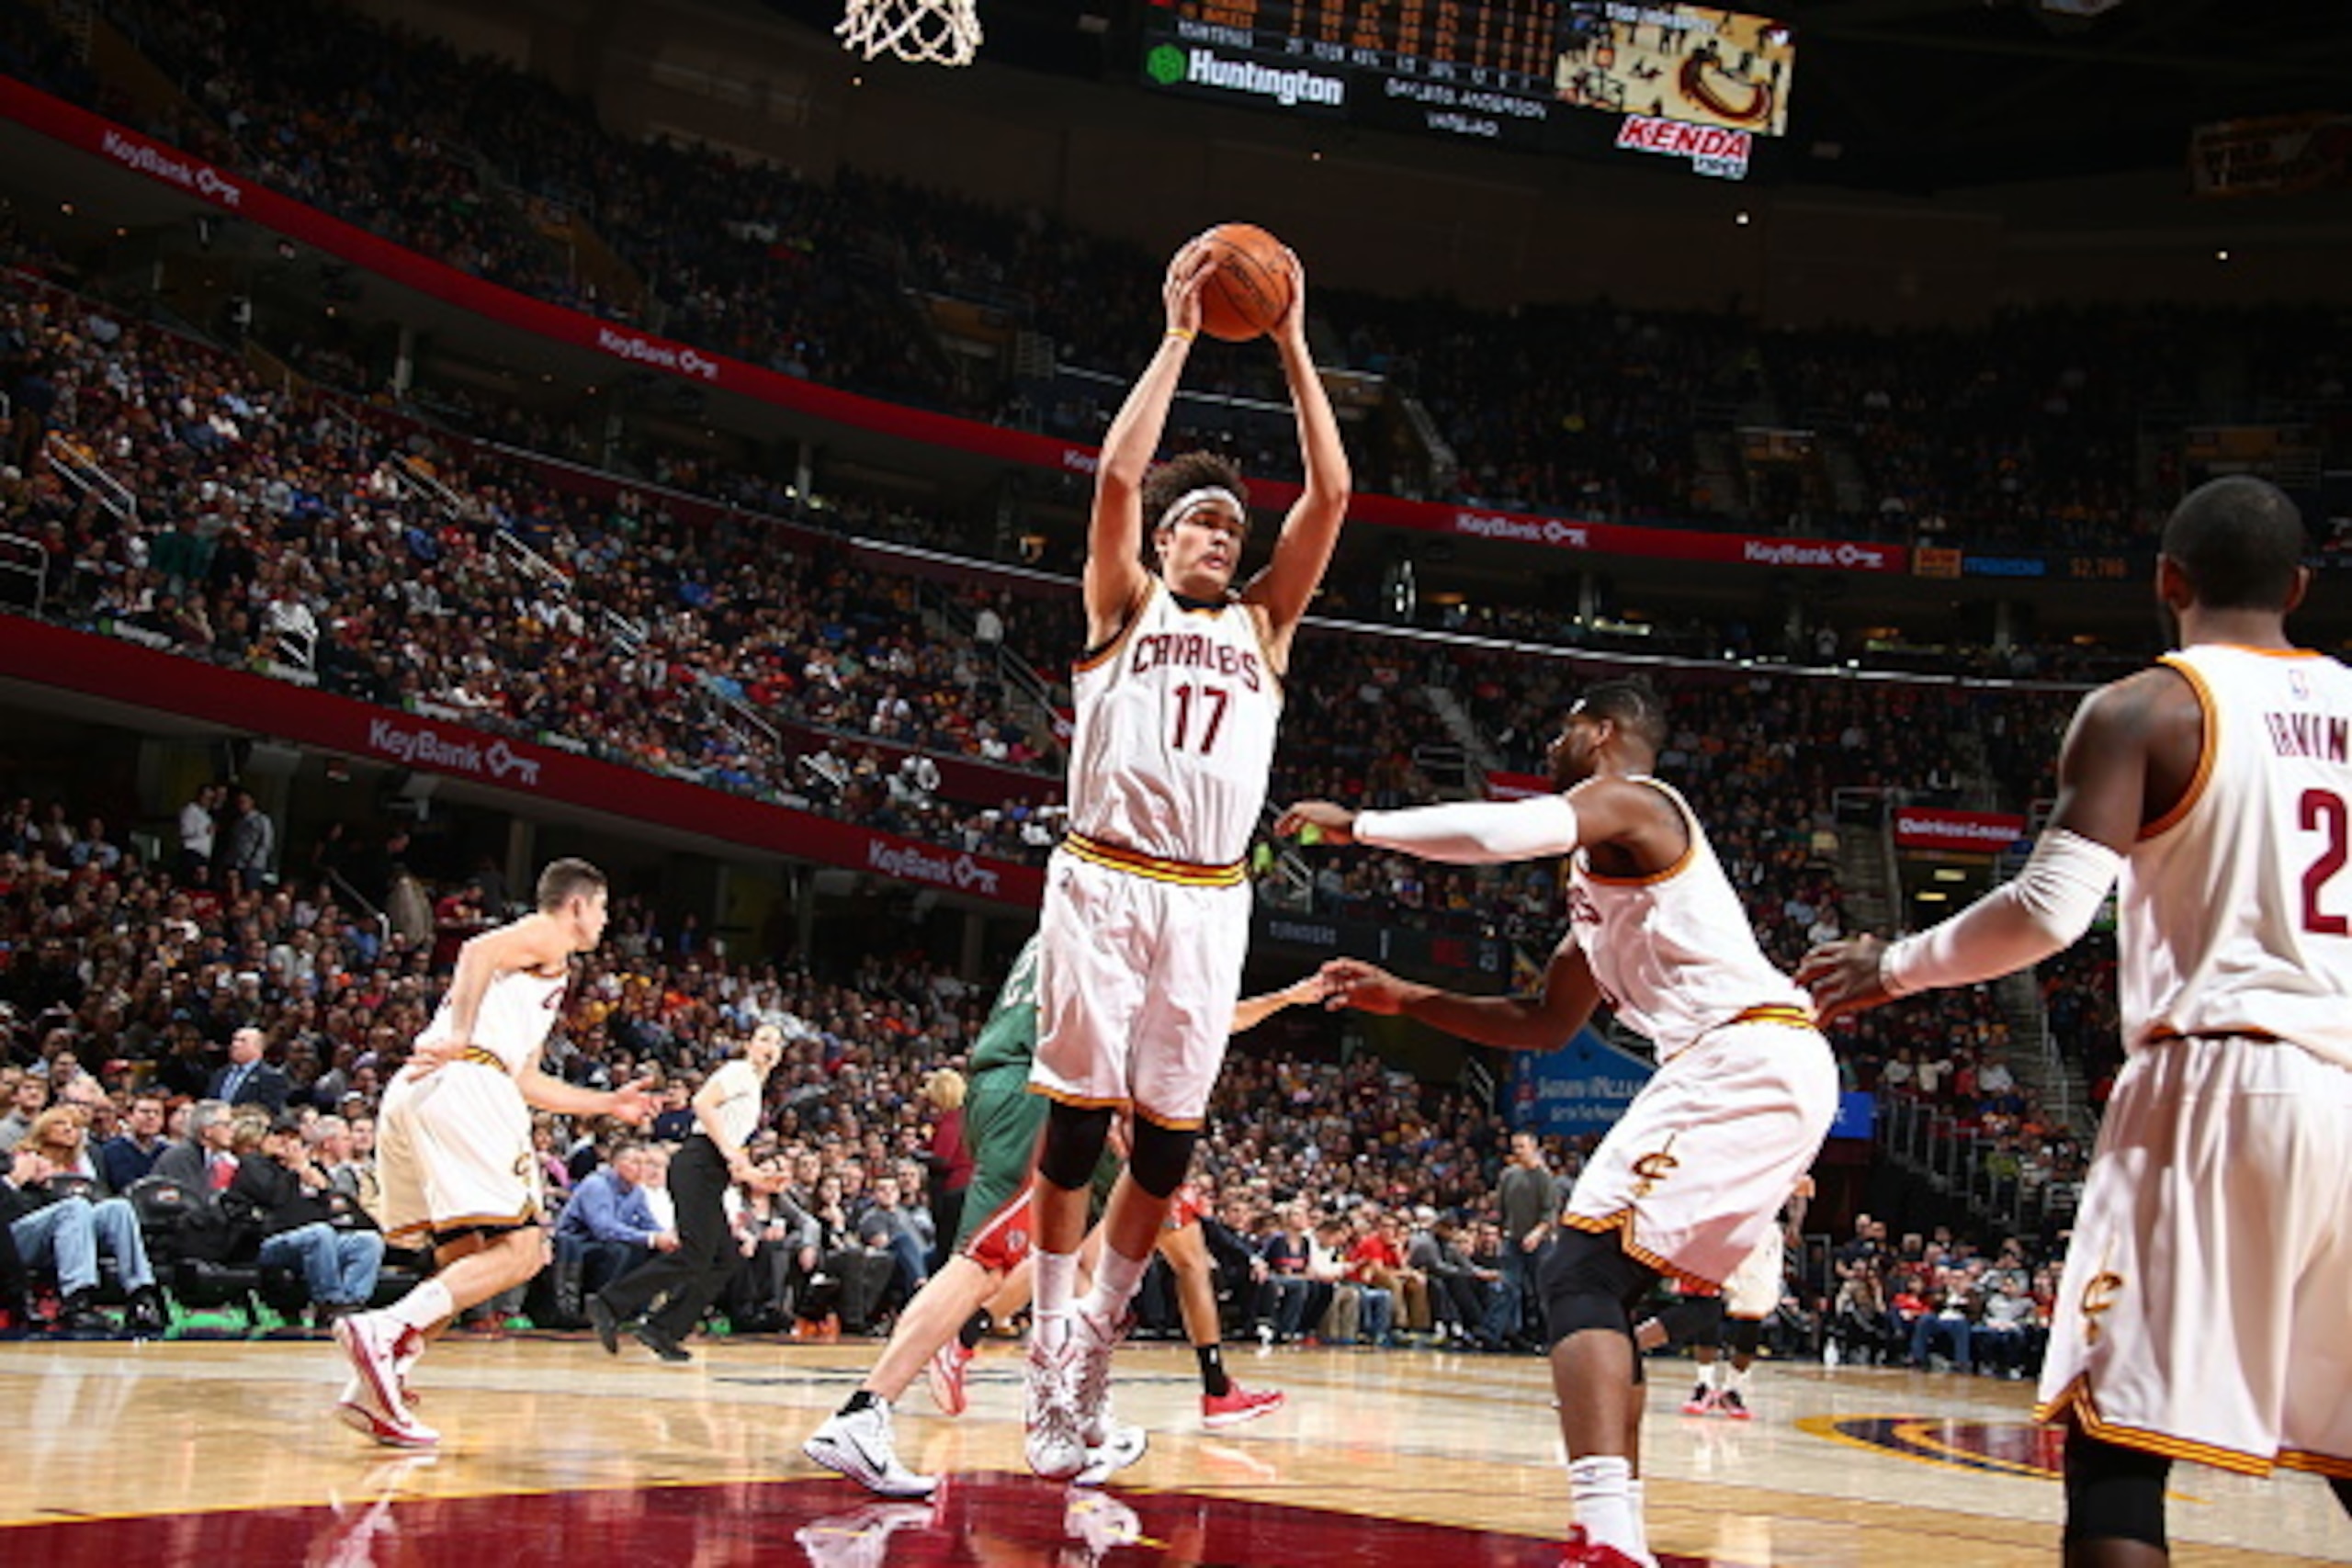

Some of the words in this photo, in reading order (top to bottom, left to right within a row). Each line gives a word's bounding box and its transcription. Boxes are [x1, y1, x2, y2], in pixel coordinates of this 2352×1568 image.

[1187, 49, 1345, 106] Huntington
[102, 128, 194, 186] KeyBank
[1617, 115, 1751, 162] KENDA
[598, 327, 678, 369] KeyBank
[1455, 513, 1542, 540] KeyBank
[1744, 540, 1835, 566] KeyBank
[1172, 682, 1228, 755] 17
[369, 718, 481, 773] KeyBank
[867, 838, 953, 884] KeyBank
[2299, 788, 2348, 935] 2
